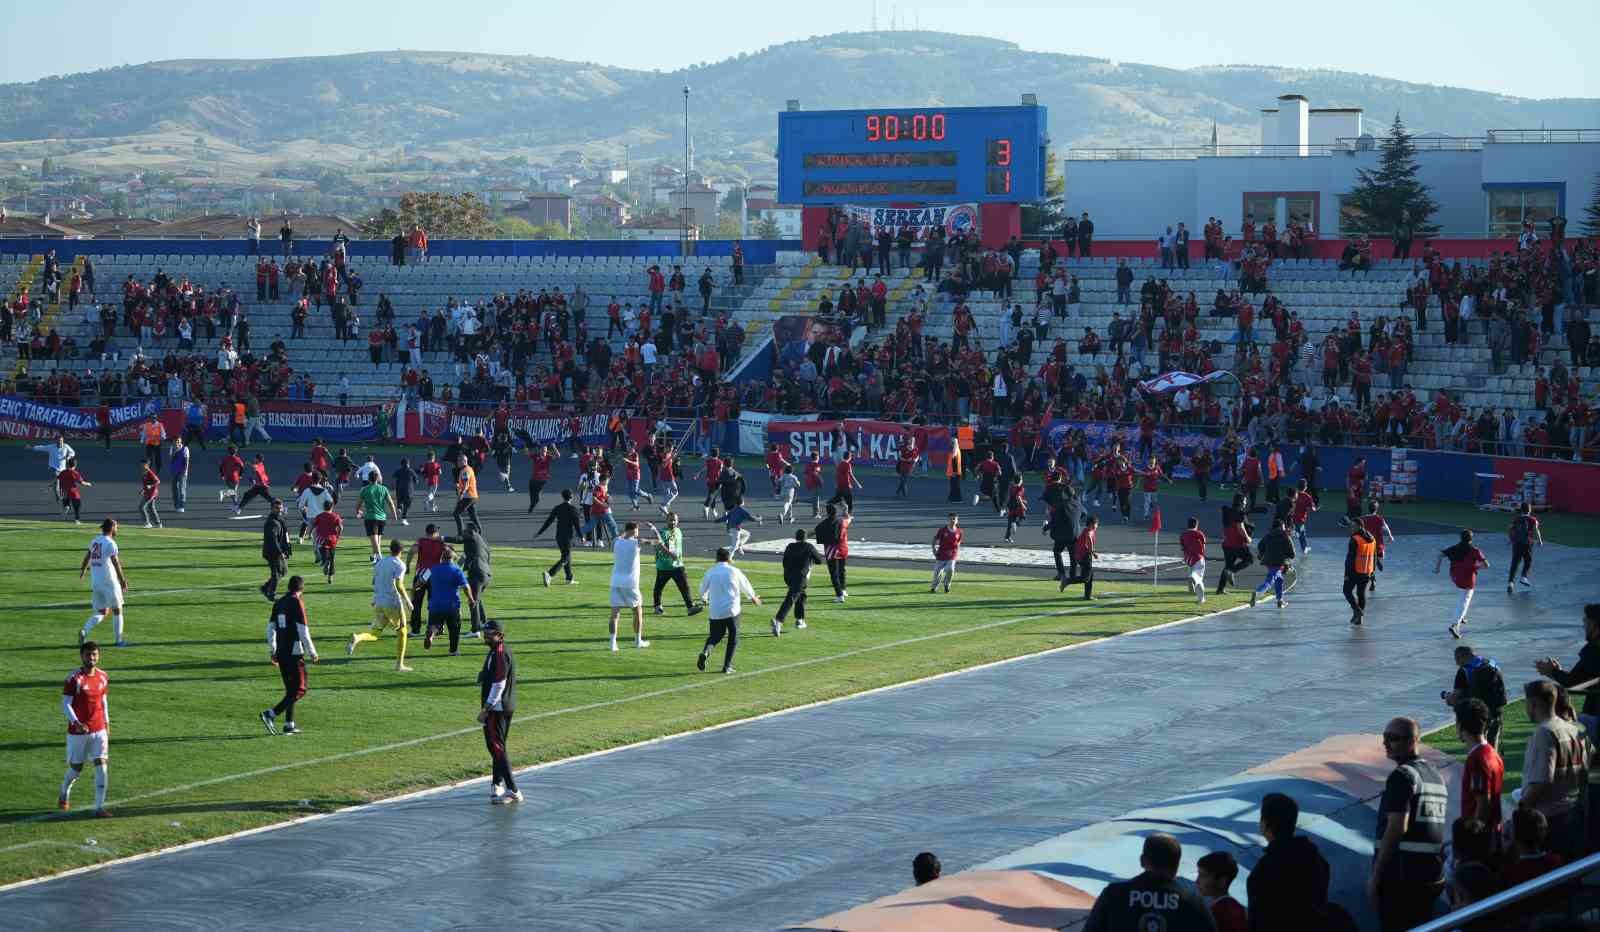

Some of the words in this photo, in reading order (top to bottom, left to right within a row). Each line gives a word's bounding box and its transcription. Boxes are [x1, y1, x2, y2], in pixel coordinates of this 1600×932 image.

[866, 113, 946, 141] 90:00
[996, 139, 1012, 166] 3
[1003, 170, 1012, 193] 1
[873, 207, 947, 226] SERKAN
[0, 397, 24, 421] ENÇ
[91, 542, 102, 560] 21
[1128, 889, 1180, 910] POLIS
